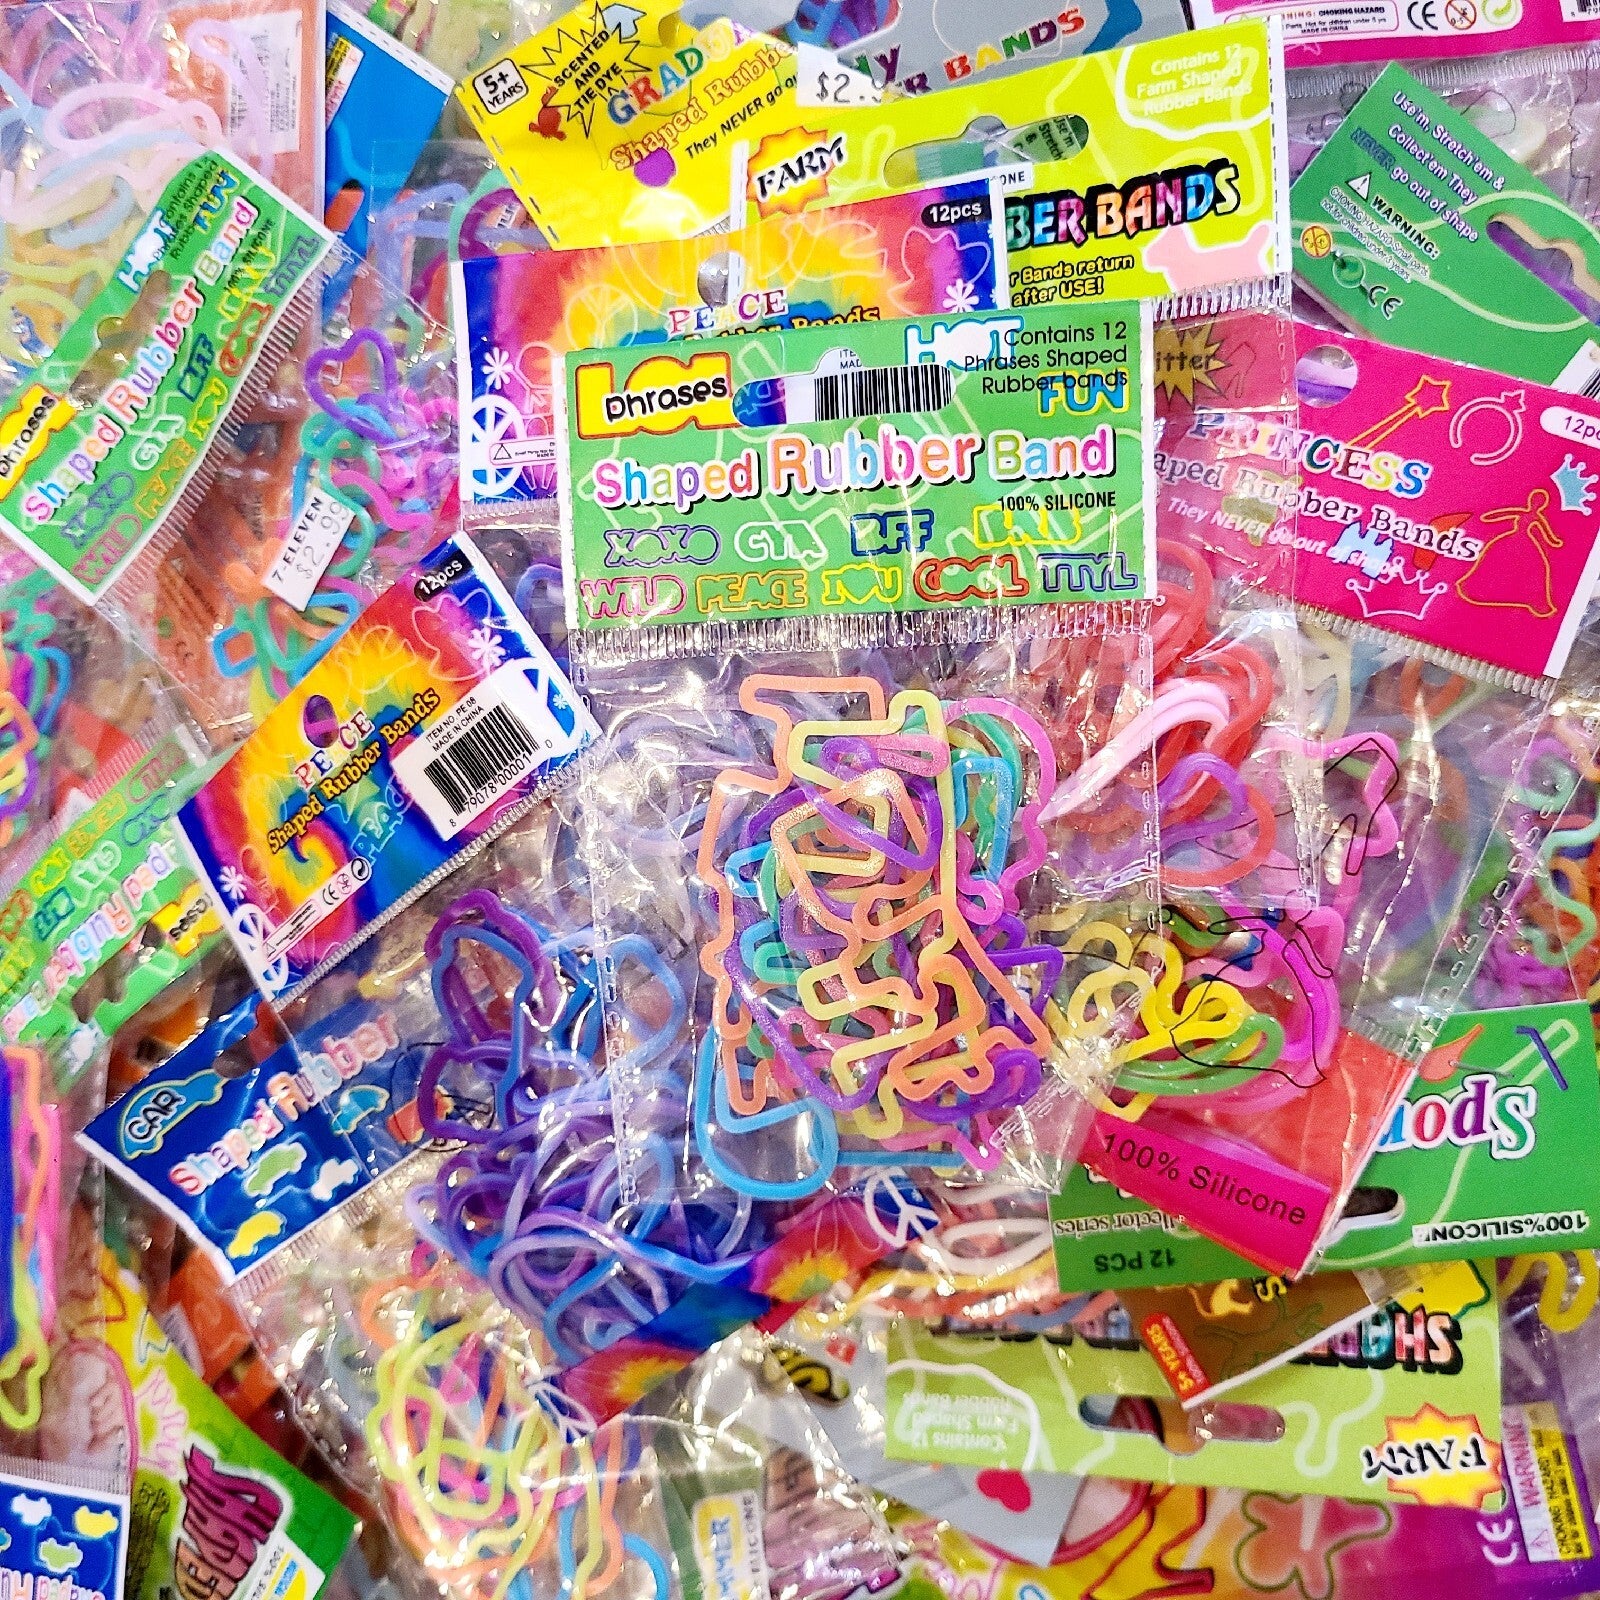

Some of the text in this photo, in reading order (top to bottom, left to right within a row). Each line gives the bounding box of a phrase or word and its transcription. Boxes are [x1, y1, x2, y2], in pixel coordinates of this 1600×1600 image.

[554, 30, 610, 87] SCENTED
[942, 7, 1086, 82] BANDS
[1151, 43, 1242, 76] Contains 12
[483, 71, 509, 94] 5+
[487, 82, 524, 108] YEARS
[574, 62, 622, 111] TIE DYE
[575, 61, 602, 91] AND
[1137, 60, 1242, 98] Farm Shaped
[1145, 81, 1253, 116] Rubber Bands
[609, 97, 707, 171] Shaped
[685, 85, 786, 161] They NEVER go
[756, 136, 846, 200] FARM
[1387, 123, 1478, 206] Collect'em They
[1431, 123, 1494, 182] Stretch'em
[1493, 175, 1506, 191] &
[193, 168, 240, 235] FUN
[1094, 163, 1241, 240] BANDS
[1330, 186, 1363, 223] CHOKING
[1350, 126, 1479, 243] NEVER go out of shape
[928, 201, 983, 225] 12pcs
[1340, 215, 1366, 243] children
[1365, 237, 1385, 259] under
[1370, 194, 1440, 261] WARNING:
[1011, 275, 1104, 307] after USE!
[1021, 260, 1074, 285] Bands
[1078, 254, 1135, 275] return
[668, 289, 787, 335] PEACE
[1004, 321, 1127, 347] Contains 12
[20, 412, 125, 523] Shaped
[104, 277, 205, 425] Rubber
[193, 195, 262, 286] Band
[904, 316, 1024, 371] HOT
[964, 345, 1127, 372] Phrases Shaped
[982, 368, 1128, 395] Rubber bands
[1037, 369, 1131, 416] FUN
[595, 423, 1117, 512] Shaped Rubber Band
[1189, 405, 1432, 499] PRINCESS
[997, 490, 1117, 513] 100% SILICONE
[1166, 498, 1210, 524] They
[1209, 511, 1271, 540] NEVER
[1291, 534, 1327, 555] out
[1235, 467, 1362, 524] Rubber
[1369, 505, 1483, 561] Bands
[272, 496, 323, 583] 7-ELEVEN
[296, 500, 350, 579] $2.99
[604, 524, 721, 568] XOXO
[418, 557, 464, 596] 12pcs
[579, 552, 1138, 618] WILD PEACE COOL TTYL
[426, 724, 444, 744] ITEM
[456, 703, 468, 717] PE
[466, 695, 478, 710] 08
[432, 706, 485, 753] MADE IN CHINA
[267, 793, 325, 855] Shaped
[319, 740, 383, 800] Rubber
[379, 687, 441, 746] Bands
[294, 710, 375, 790] PEACE
[449, 818, 457, 828] 8
[43, 892, 134, 996] Rubber
[126, 1088, 184, 1143] CAR
[168, 1099, 284, 1197] Shaped
[1103, 1133, 1307, 1227] 100% Silicone
[1054, 1213, 1110, 1237] series
[1093, 1248, 1176, 1273] 12 PCS
[1145, 1322, 1184, 1372] YEARS
[1362, 1437, 1488, 1479] FARM
